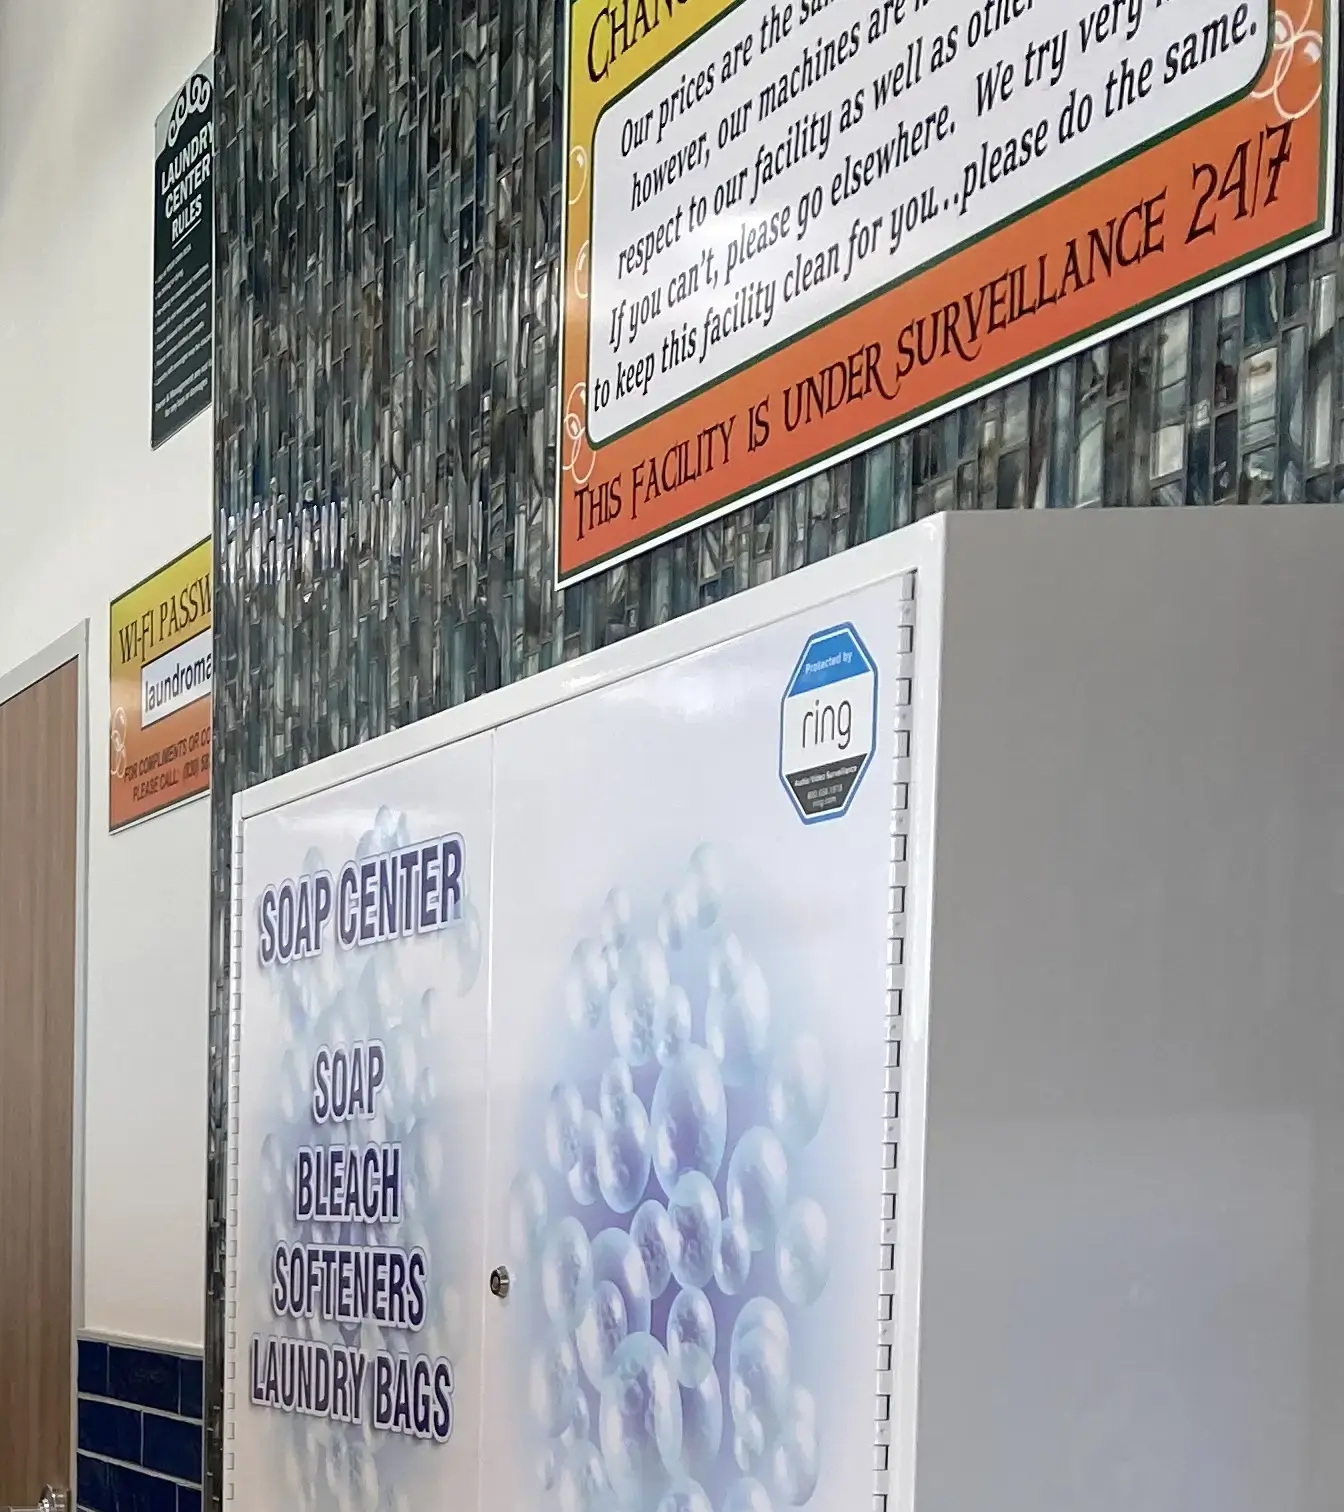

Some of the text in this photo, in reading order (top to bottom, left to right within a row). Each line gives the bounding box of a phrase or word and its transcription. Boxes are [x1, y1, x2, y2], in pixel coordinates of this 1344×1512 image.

[587, 0, 687, 82] CHAN
[622, 110, 653, 158] Our
[657, 62, 715, 143] prices
[721, 34, 753, 84] are
[760, 5, 792, 55] the
[618, 0, 1034, 279] respect to our facility as well as othe
[631, 0, 906, 211] however, our machines are
[161, 121, 213, 195] LAUNDRY
[165, 153, 211, 219] CENTER
[609, 0, 1142, 352] If you can't, please go elsewhere. We try very
[172, 193, 202, 242] RULES
[593, 376, 610, 412] to
[615, 355, 655, 401] keep
[661, 325, 697, 374] this
[700, 279, 776, 364] facility
[783, 239, 841, 302] clean
[844, 214, 883, 285] for
[1058, 88, 1093, 144] do
[1105, 57, 1153, 118] the
[1164, 2, 1257, 84] same.
[573, 118, 1296, 541] THIS FACILITY IS UNDER SURVEILLANCE 24/7
[118, 606, 155, 665] WI-FI
[802, 699, 852, 750] ring
[260, 838, 464, 963] SOAP CENTER
[313, 1043, 385, 1122] SOAP
[297, 1142, 401, 1222] BLEACH
[274, 1246, 425, 1327] SOFTENERS
[251, 1334, 453, 1441] LAUNDRY BAGS
